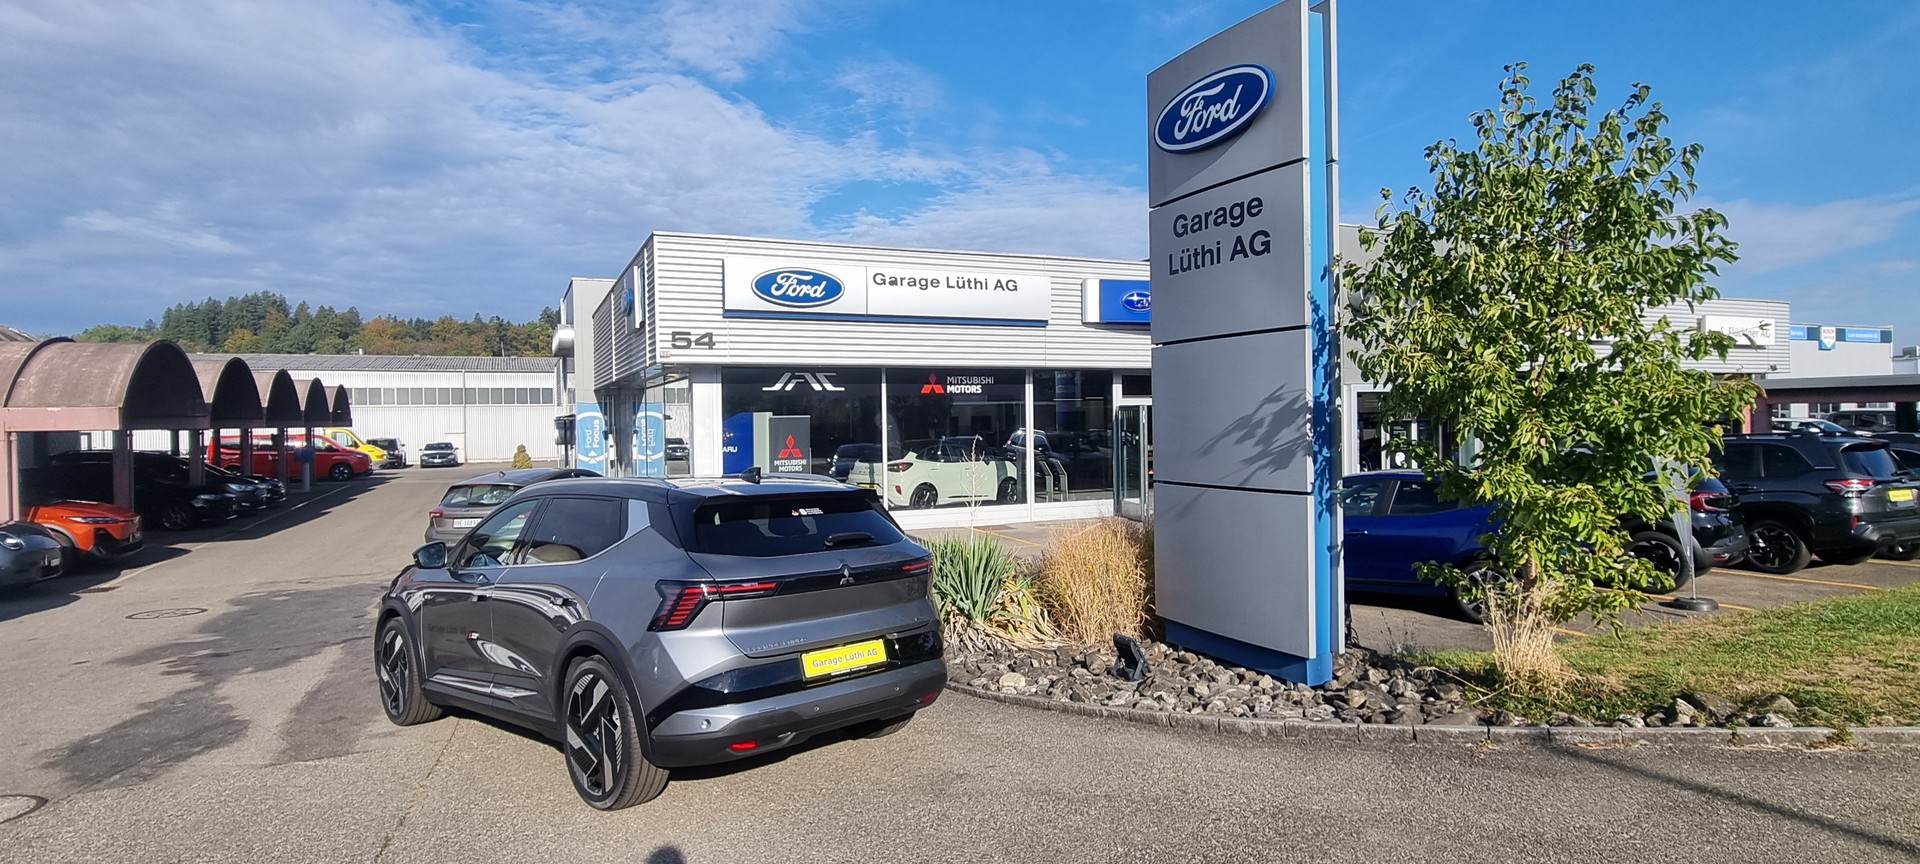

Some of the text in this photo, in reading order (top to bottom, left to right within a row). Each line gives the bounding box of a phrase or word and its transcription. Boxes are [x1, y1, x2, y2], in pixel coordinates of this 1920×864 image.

[1174, 82, 1243, 140] Ford
[1173, 196, 1263, 238] Garage
[1169, 230, 1271, 276] Lüthi AG
[770, 271, 827, 298] Ford
[873, 272, 1018, 292] Garage Lüthi AG
[671, 331, 716, 350] 54
[947, 376, 994, 385] MITSUBISHI
[947, 385, 982, 393] MOTORS
[812, 648, 878, 668] Garage Lüthi AG
